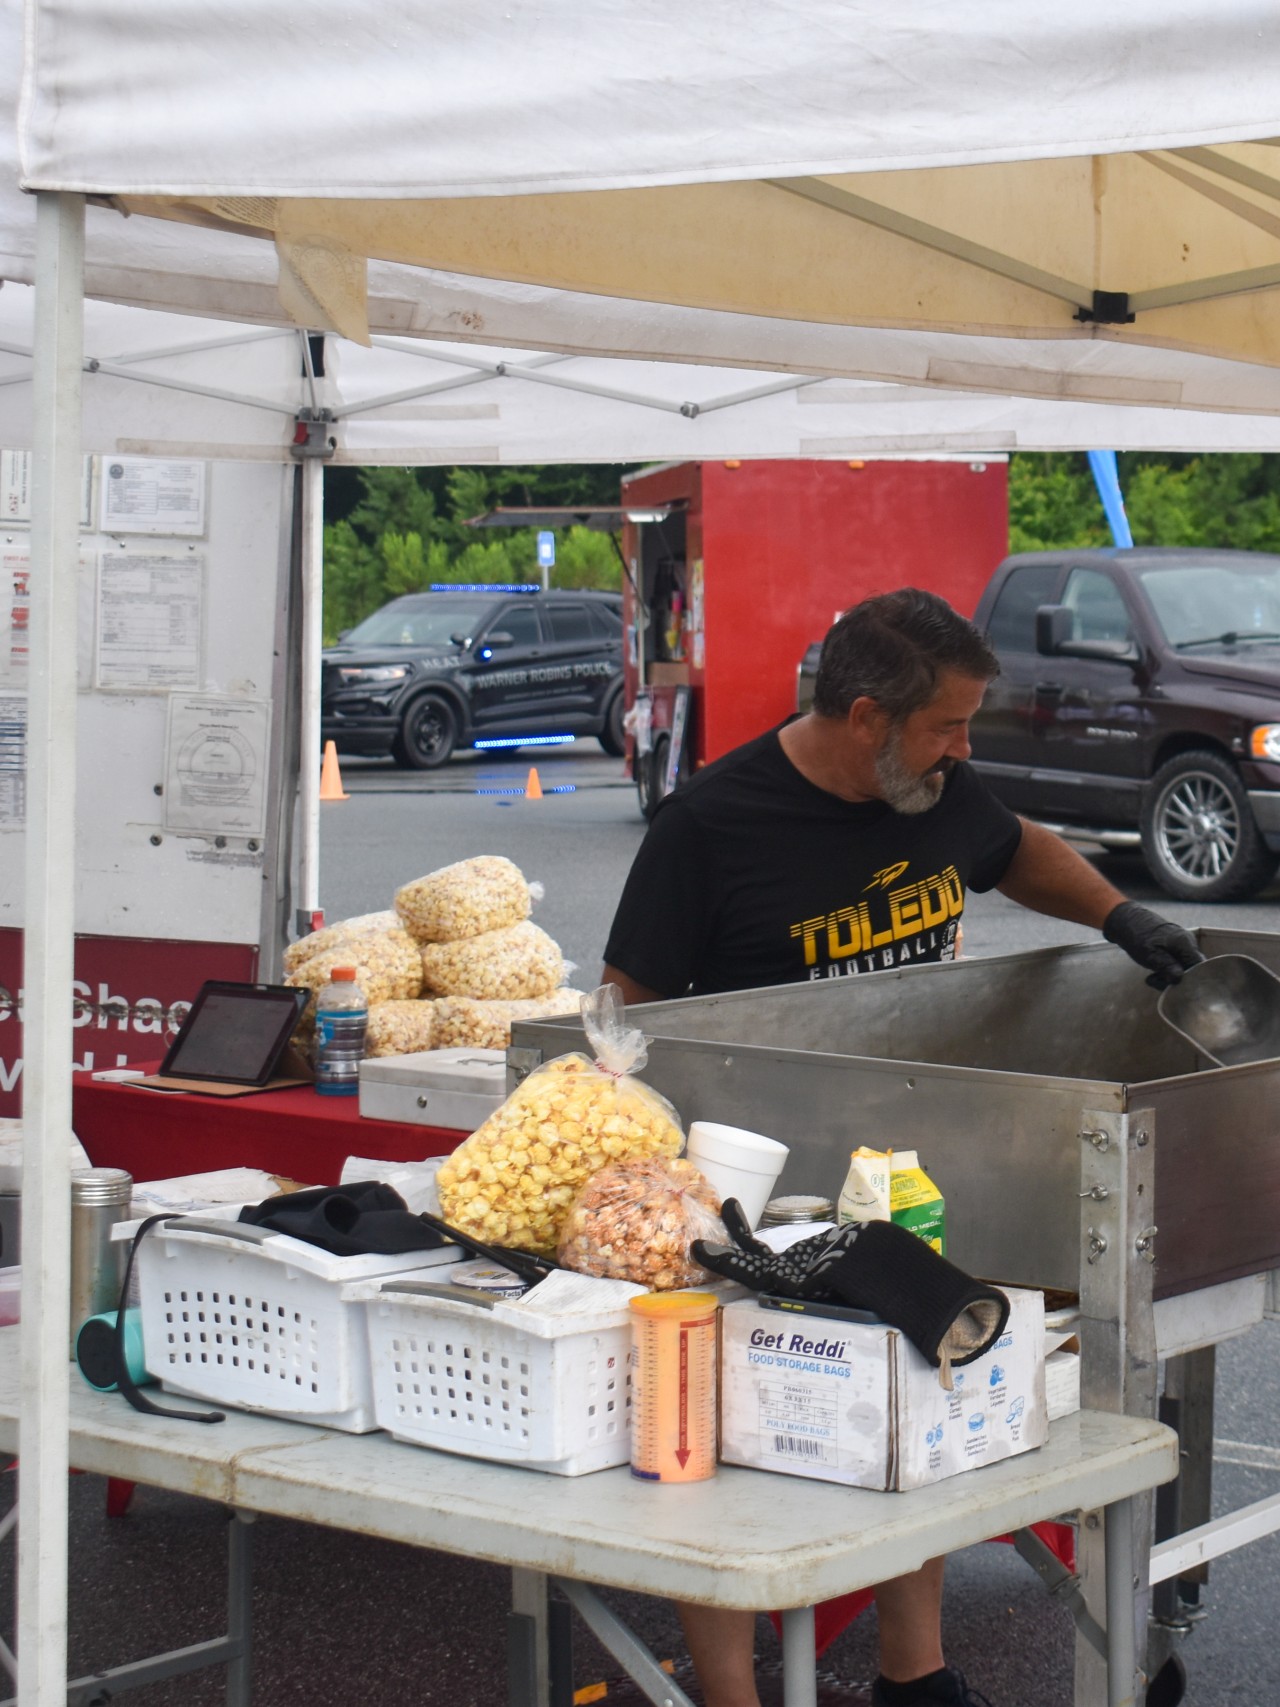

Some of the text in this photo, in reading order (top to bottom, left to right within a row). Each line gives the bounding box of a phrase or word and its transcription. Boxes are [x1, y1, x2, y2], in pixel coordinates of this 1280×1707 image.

[478, 660, 612, 689] WARNER ROBINS POLICE
[789, 865, 964, 966] TOLEDO
[809, 932, 938, 980] FOOTBALL
[919, 1220, 942, 1229] MEDAL
[503, 1290, 521, 1298] Facts
[750, 1328, 846, 1359] Get Reddi
[993, 1336, 1013, 1351] BAGS
[748, 1352, 852, 1379] FOOD STORAGE BAGS
[766, 1418, 785, 1429] POLY
[809, 1426, 831, 1437] BAGS
